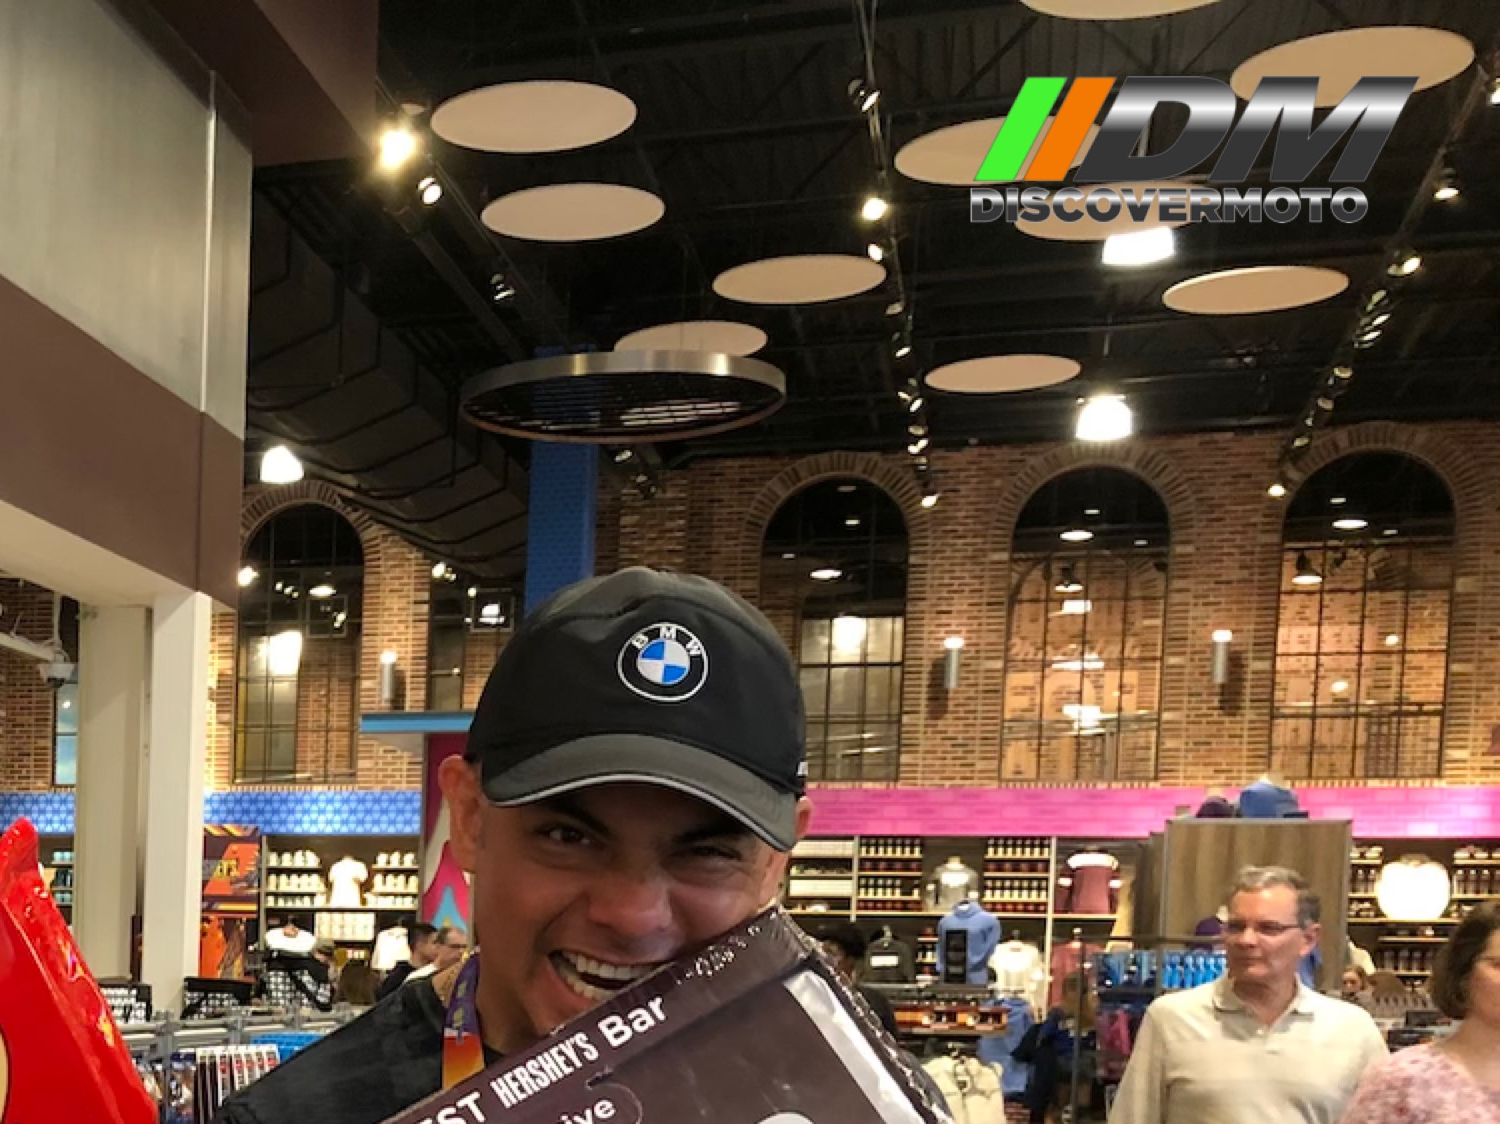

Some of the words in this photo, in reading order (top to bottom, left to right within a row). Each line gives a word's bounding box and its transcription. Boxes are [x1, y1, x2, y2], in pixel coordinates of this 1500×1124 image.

[631, 623, 701, 656] BMW
[489, 1031, 599, 1109] HERSHEY'S
[597, 996, 667, 1048] Bar
